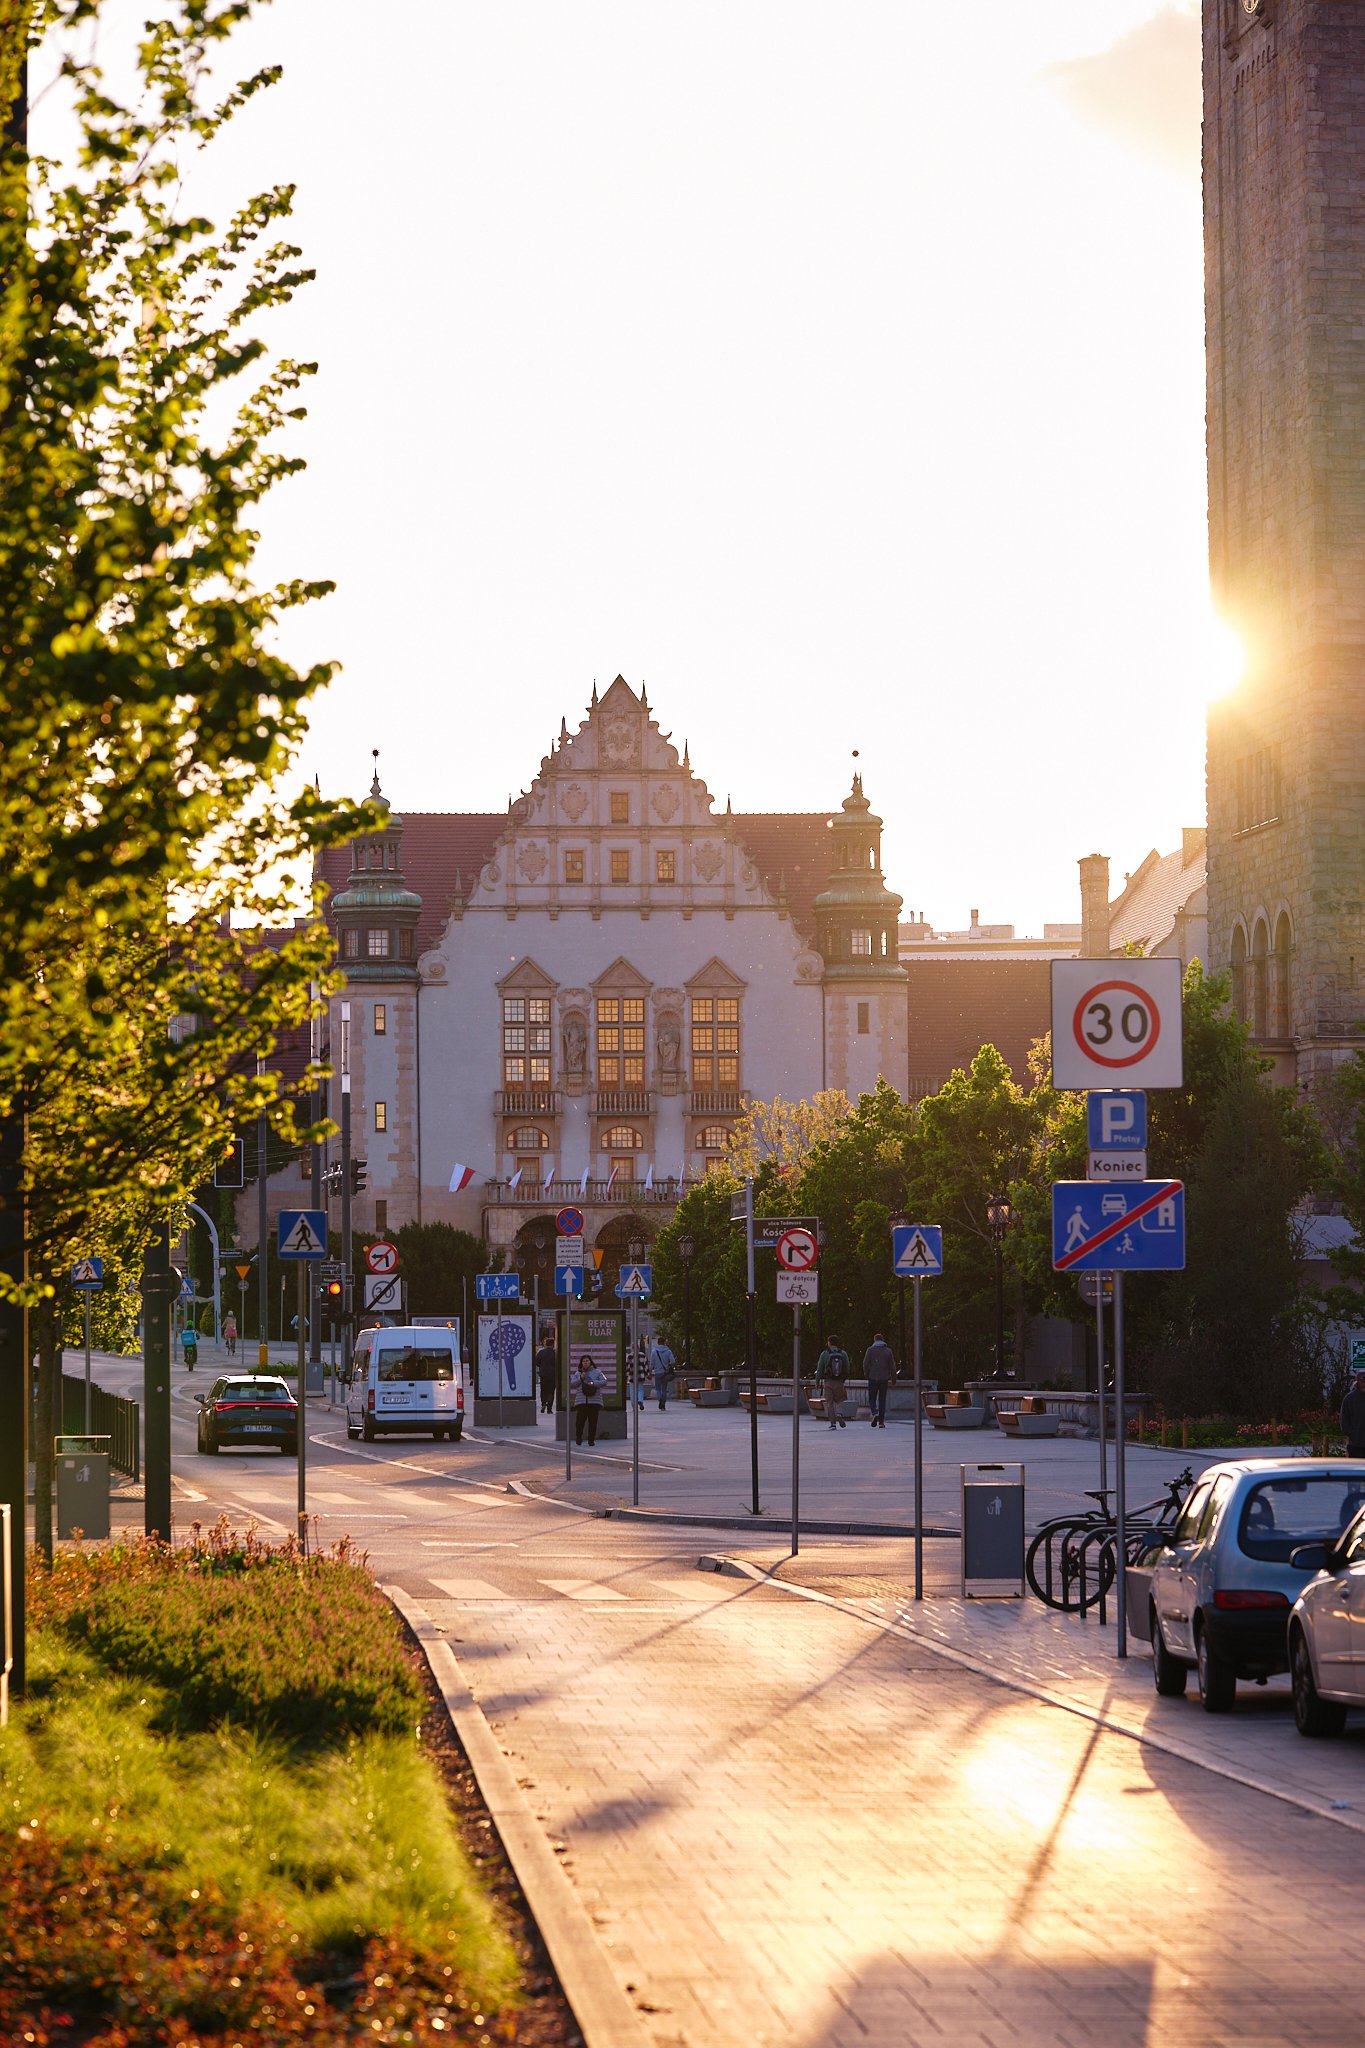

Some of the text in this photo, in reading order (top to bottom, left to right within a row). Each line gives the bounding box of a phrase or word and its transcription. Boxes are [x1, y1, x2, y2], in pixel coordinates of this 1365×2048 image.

[1086, 1003, 1149, 1045] 30
[1102, 1098, 1135, 1143] P
[1093, 1160, 1142, 1172] Koniec
[588, 1319, 617, 1328] REPER
[588, 1328, 612, 1337] TUAR
